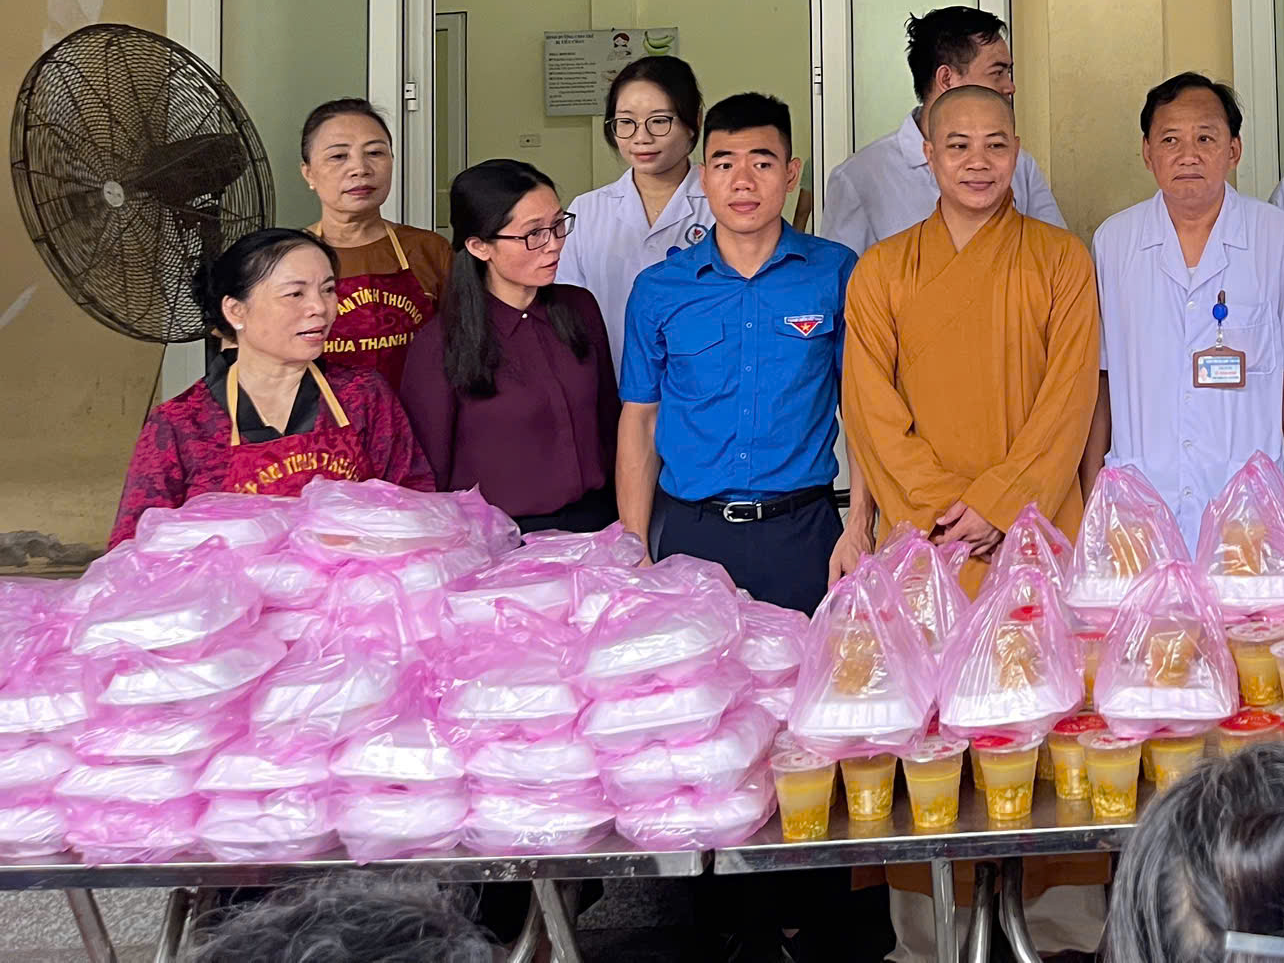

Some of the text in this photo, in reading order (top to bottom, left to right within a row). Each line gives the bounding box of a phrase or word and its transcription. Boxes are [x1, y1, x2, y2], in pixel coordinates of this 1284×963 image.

[351, 286, 380, 306] TÌNH
[323, 337, 356, 353] HÙA
[358, 332, 407, 351] THANH
